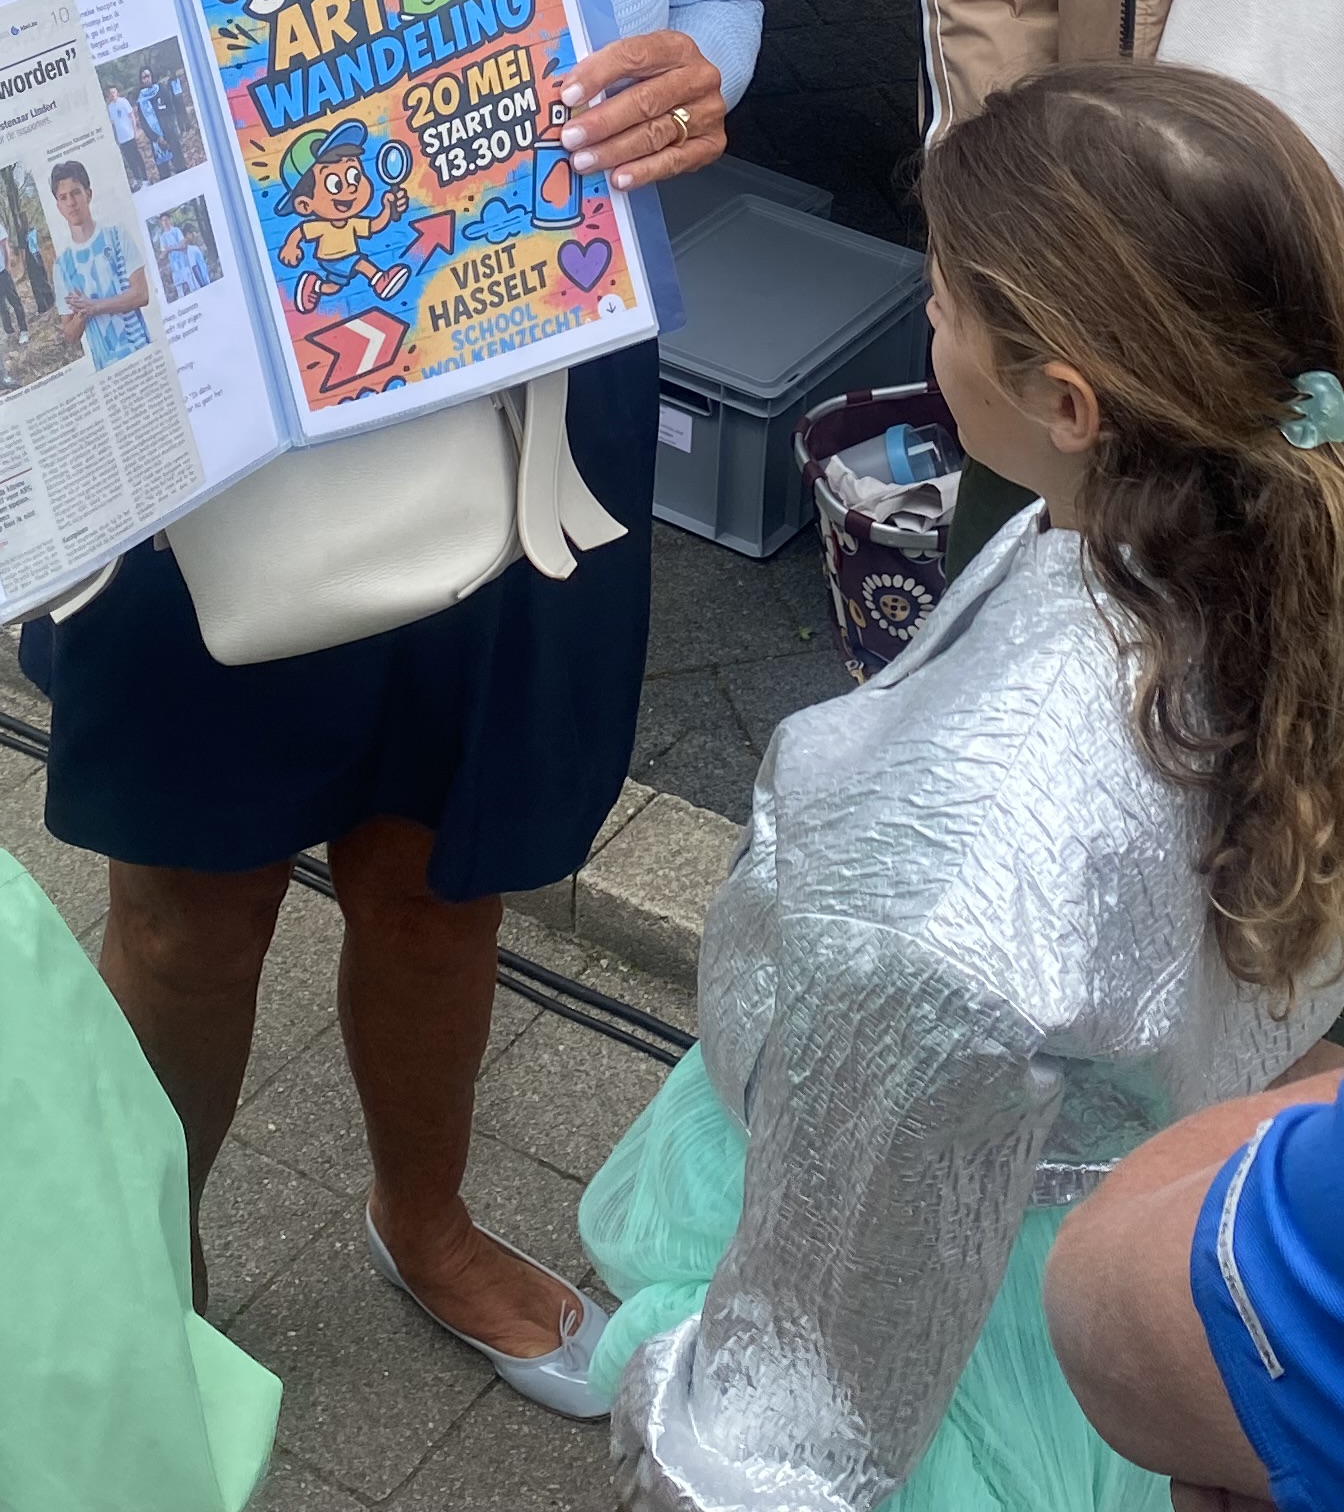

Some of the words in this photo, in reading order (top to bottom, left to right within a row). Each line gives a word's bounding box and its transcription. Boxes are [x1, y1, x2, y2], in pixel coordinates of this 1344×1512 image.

[51, 7, 70, 25] 10
[407, 78, 460, 128] 20
[466, 48, 531, 105] MEI
[423, 104, 494, 153] START
[497, 88, 537, 125] OM
[434, 133, 509, 182] 13.30
[515, 120, 533, 146] U
[428, 260, 548, 332] HASSELT
[450, 243, 517, 290] VISIT
[451, 302, 537, 352] SCHOOL
